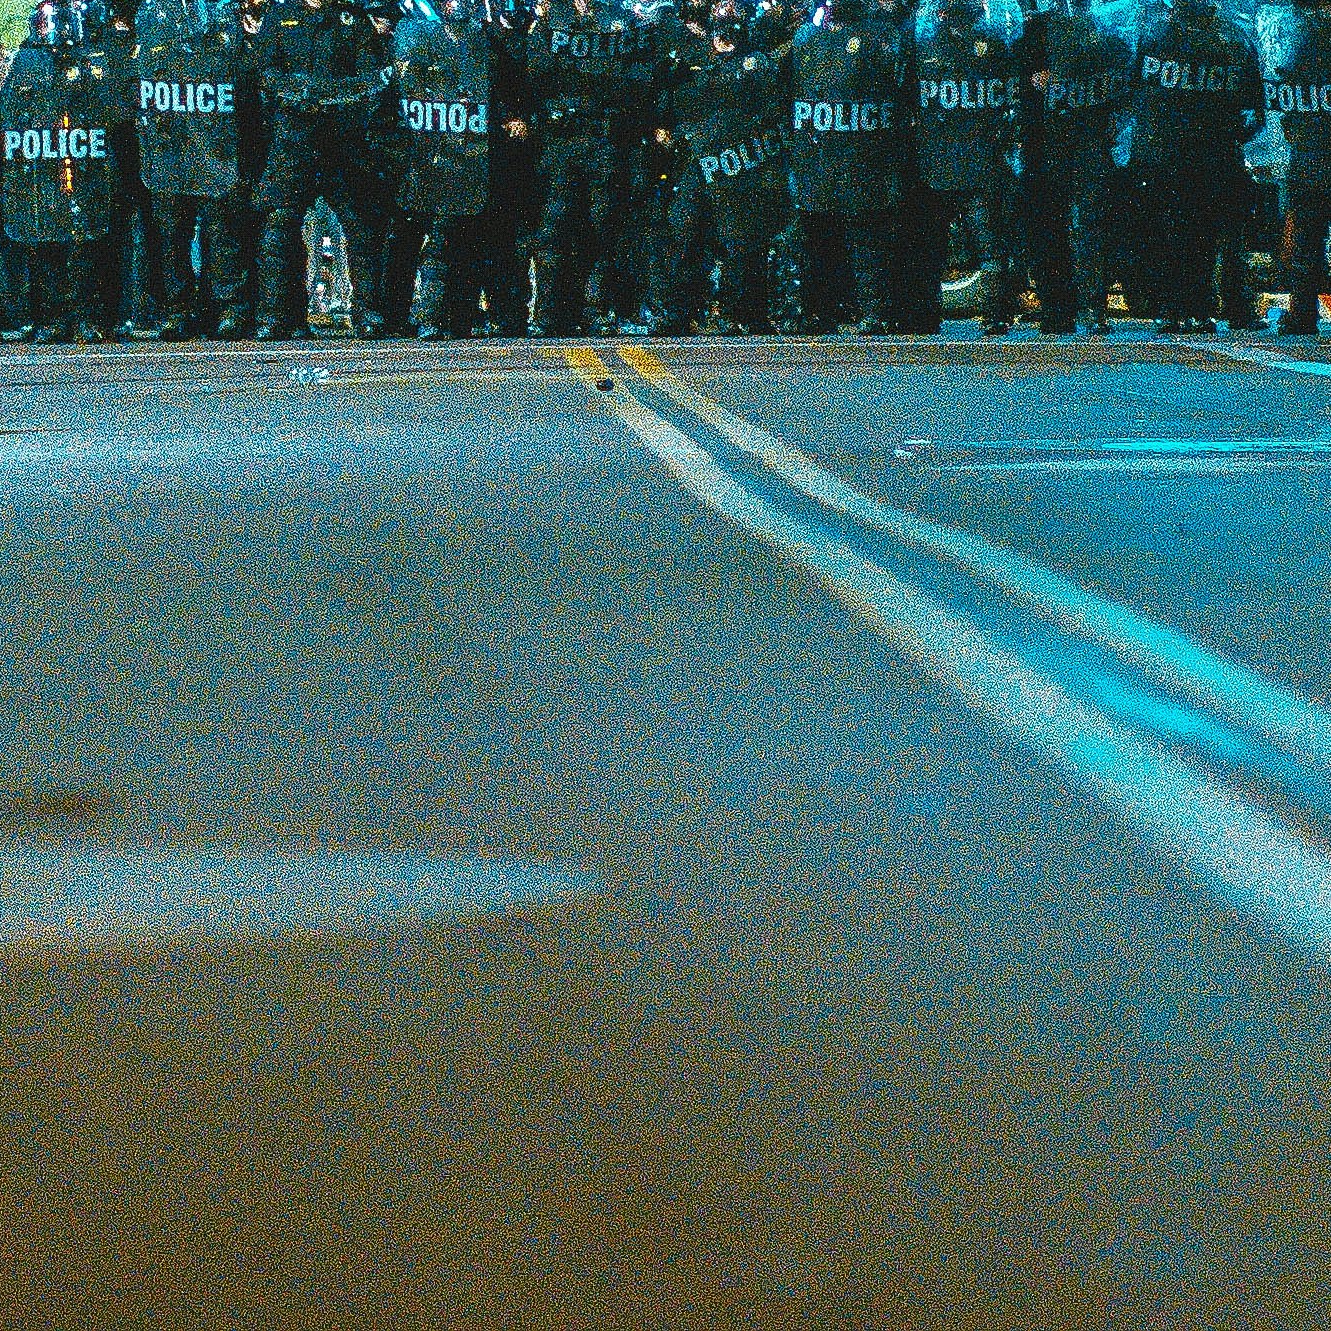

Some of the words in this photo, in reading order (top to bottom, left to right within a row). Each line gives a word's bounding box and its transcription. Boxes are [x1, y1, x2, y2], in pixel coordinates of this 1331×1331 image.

[139, 79, 235, 114] POLICE
[919, 76, 1021, 110] POLICE
[793, 100, 896, 132] POLICE
[4, 128, 107, 160] POLICE
